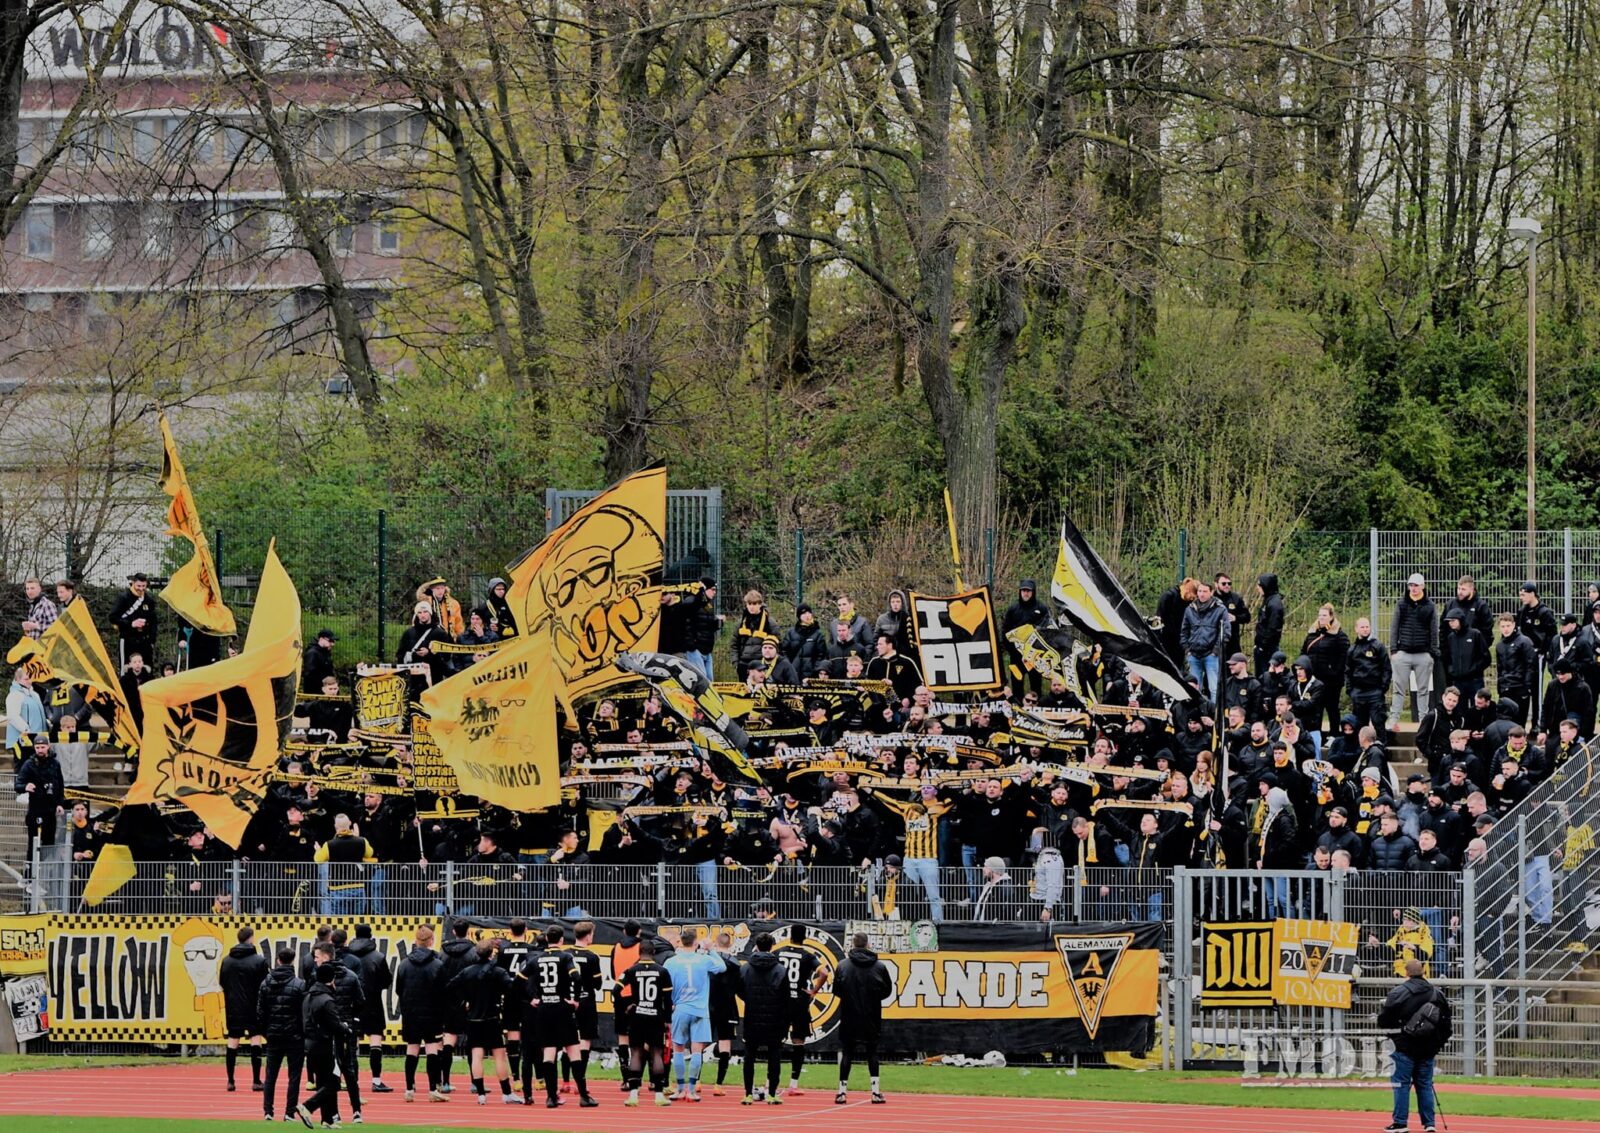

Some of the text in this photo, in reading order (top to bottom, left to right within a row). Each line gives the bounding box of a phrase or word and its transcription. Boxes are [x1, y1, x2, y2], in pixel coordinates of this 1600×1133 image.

[916, 600, 952, 639] I
[921, 641, 993, 685] AC
[1064, 940, 1125, 950] ALEMANNIA
[539, 962, 559, 987] 33
[1081, 952, 1104, 976] A
[1281, 951, 1347, 974] 20 11
[49, 936, 169, 1020] YELLOW
[637, 977, 658, 1001] 16
[1281, 979, 1348, 1004] JONGE
